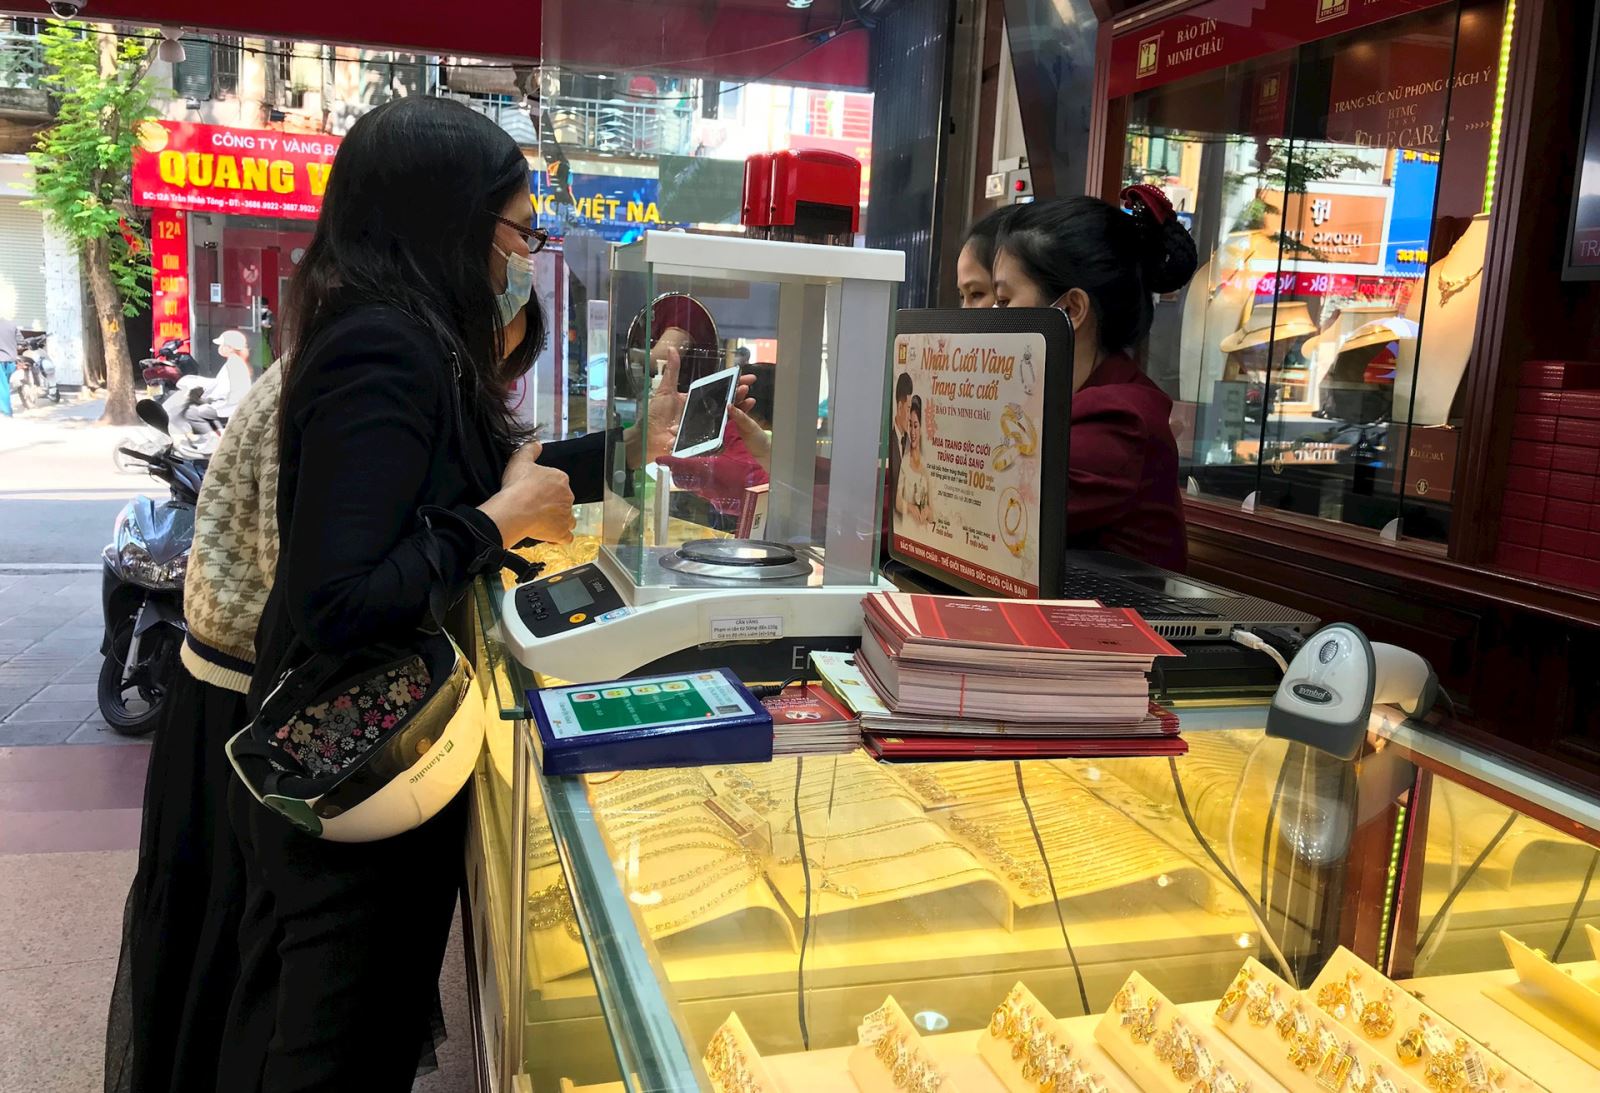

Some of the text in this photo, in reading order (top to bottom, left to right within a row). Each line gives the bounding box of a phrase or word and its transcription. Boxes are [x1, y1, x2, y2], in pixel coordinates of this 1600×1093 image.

[1177, 17, 1218, 44] BẢO TÍN
[1167, 36, 1224, 67] MINH CHÂU
[1335, 97, 1365, 113] TRANG
[1366, 90, 1385, 106] SỨC
[1404, 79, 1443, 98] PHONG
[212, 131, 255, 149] CÔNG
[258, 138, 278, 151] TY
[282, 138, 321, 154] VÀNG
[159, 149, 295, 194] QUANG
[575, 193, 620, 224] VIỆT
[627, 201, 675, 224] NA
[158, 221, 181, 239] 12A
[921, 345, 949, 371] Nhẫn
[952, 347, 979, 372] Cưới
[981, 348, 1015, 380] Vàng
[931, 375, 1000, 401] Trang sức cưới
[936, 403, 992, 421] BẢO TÍN MINH CHÂU
[932, 437, 991, 457] MUA TRANG SỨC CƯỚI
[937, 450, 954, 463] TRÚNG
[968, 457, 985, 470] SANG
[969, 470, 986, 490] 100
[960, 564, 975, 577] TRANG
[975, 570, 986, 581] SỨC
[987, 575, 1000, 587] CƯỚI
[1001, 579, 1013, 592] CỦA
[1299, 687, 1328, 700] symbol
[409, 751, 445, 784] Manulife
